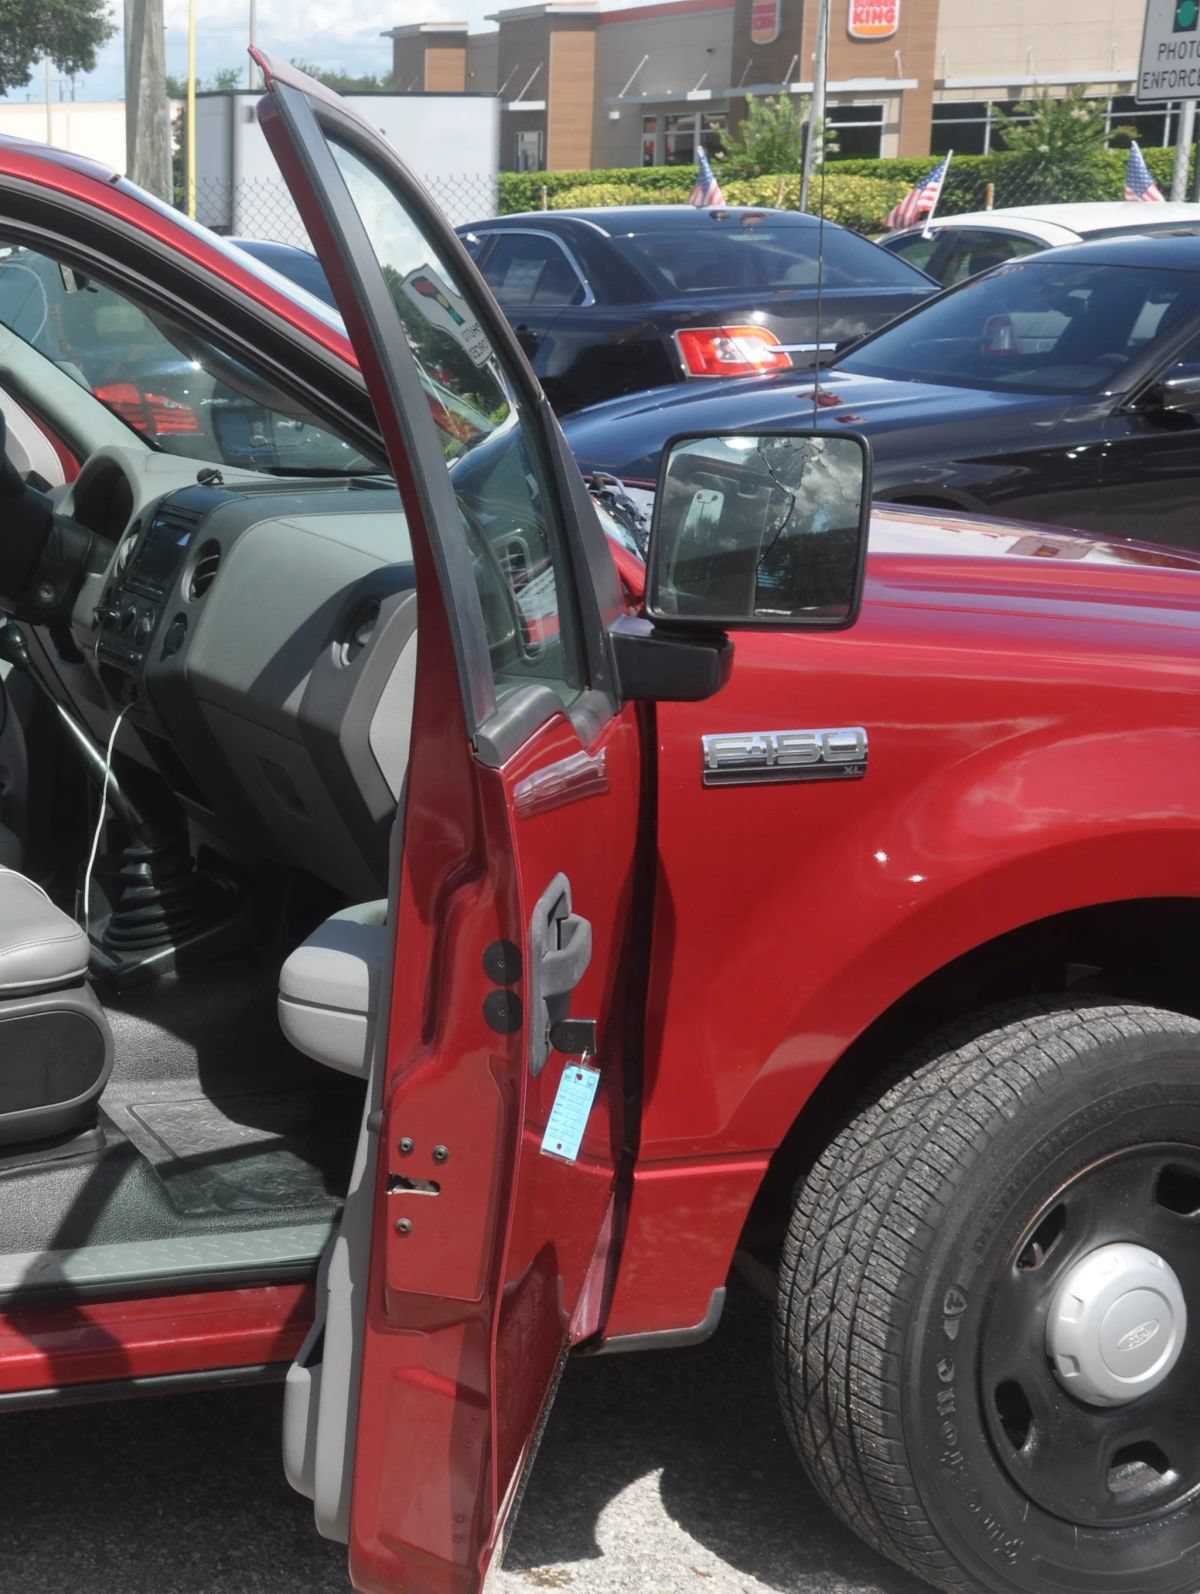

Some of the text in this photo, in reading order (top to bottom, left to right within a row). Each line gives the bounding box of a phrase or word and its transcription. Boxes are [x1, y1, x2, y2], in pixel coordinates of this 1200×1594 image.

[853, 7, 895, 24] KING
[707, 731, 865, 768] F-150
[843, 766, 863, 774] XL
